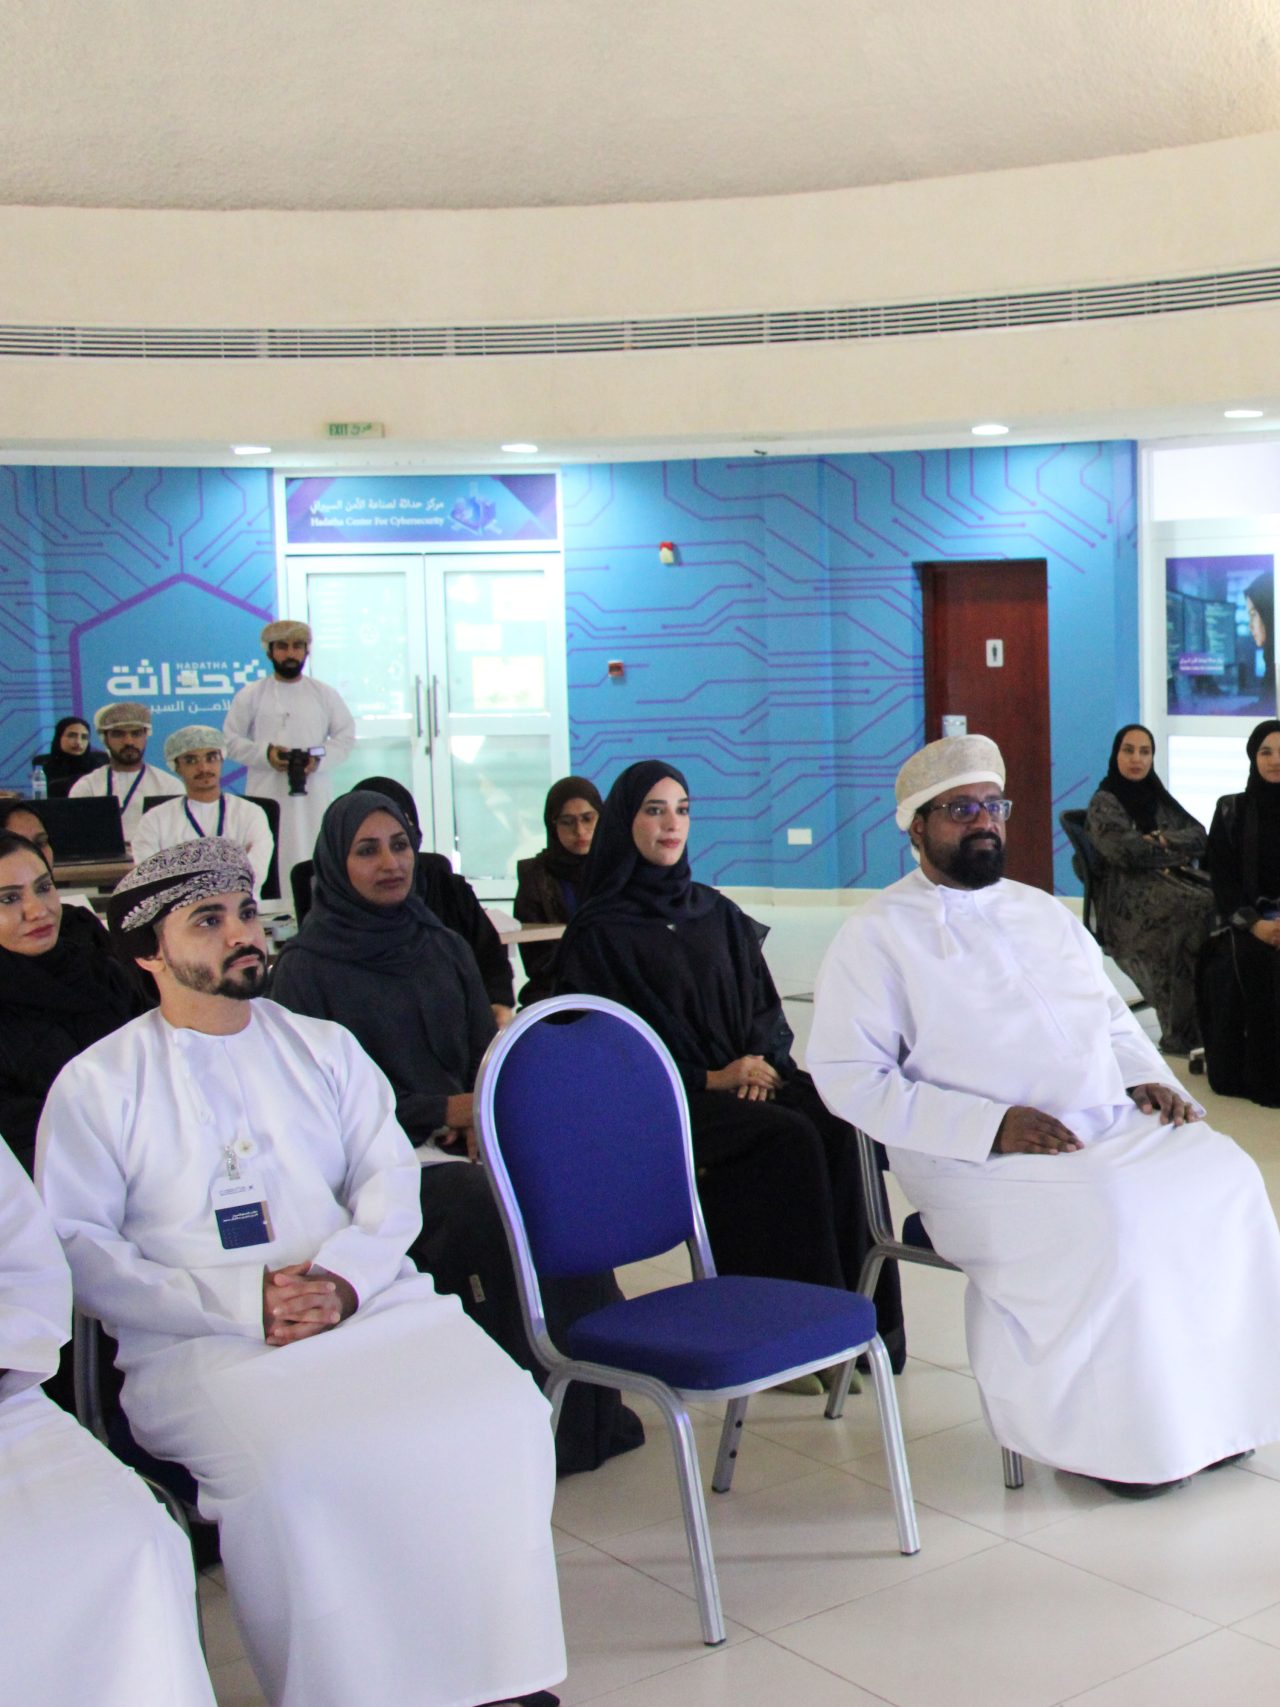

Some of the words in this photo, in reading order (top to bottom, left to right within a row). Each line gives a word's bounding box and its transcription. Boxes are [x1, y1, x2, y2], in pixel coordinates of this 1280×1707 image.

[311, 516, 344, 527] Hadatha
[346, 516, 372, 526] Center
[374, 516, 389, 526] For
[390, 516, 444, 527] Cybersecurity
[176, 661, 228, 670] HADATHA
